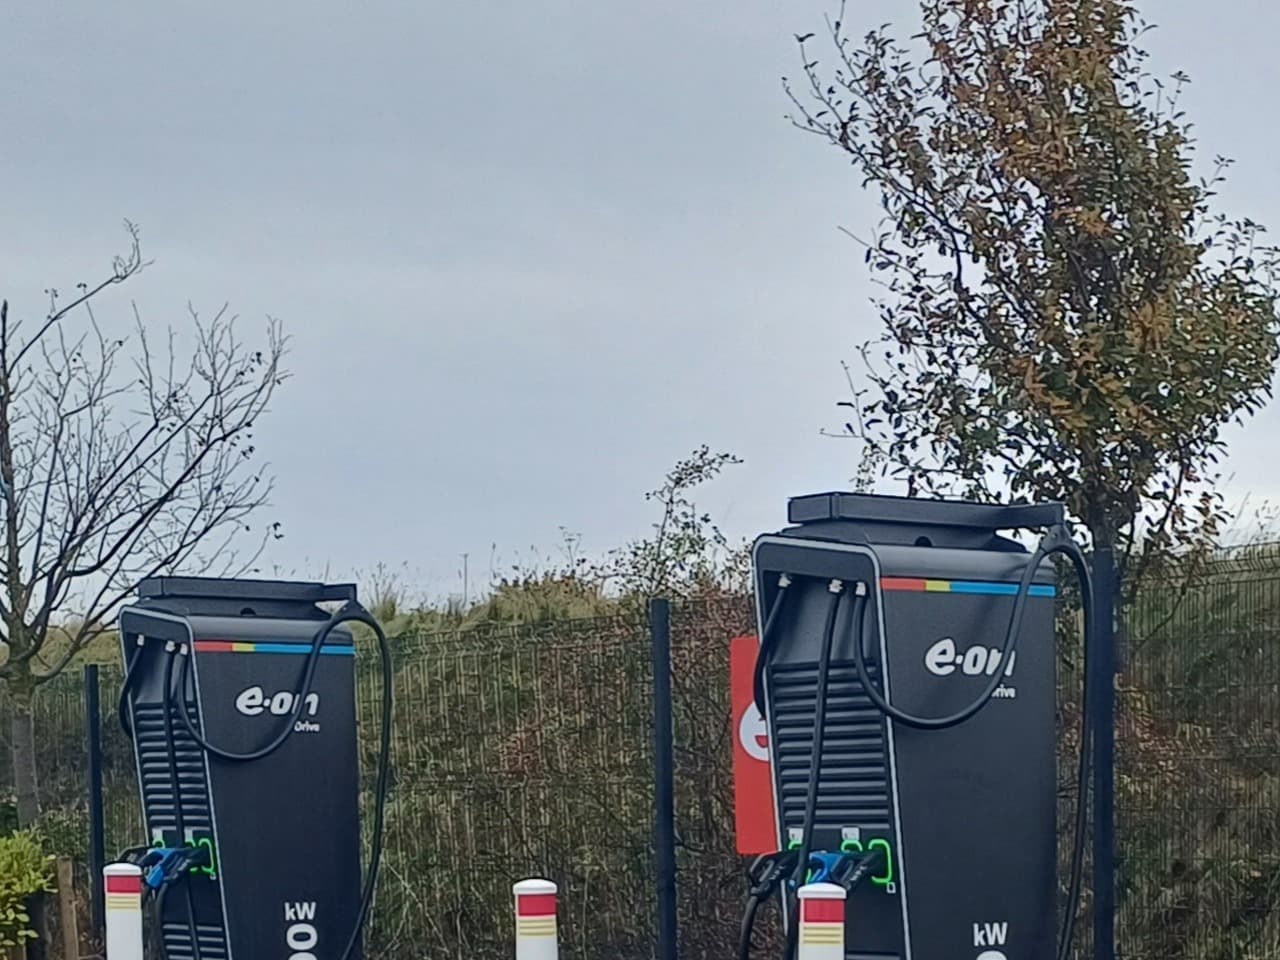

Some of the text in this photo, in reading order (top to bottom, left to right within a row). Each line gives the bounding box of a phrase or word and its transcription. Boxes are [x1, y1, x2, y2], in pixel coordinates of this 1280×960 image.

[991, 683, 1016, 698] rive
[284, 902, 316, 920] kW
[973, 922, 1008, 946] kW
